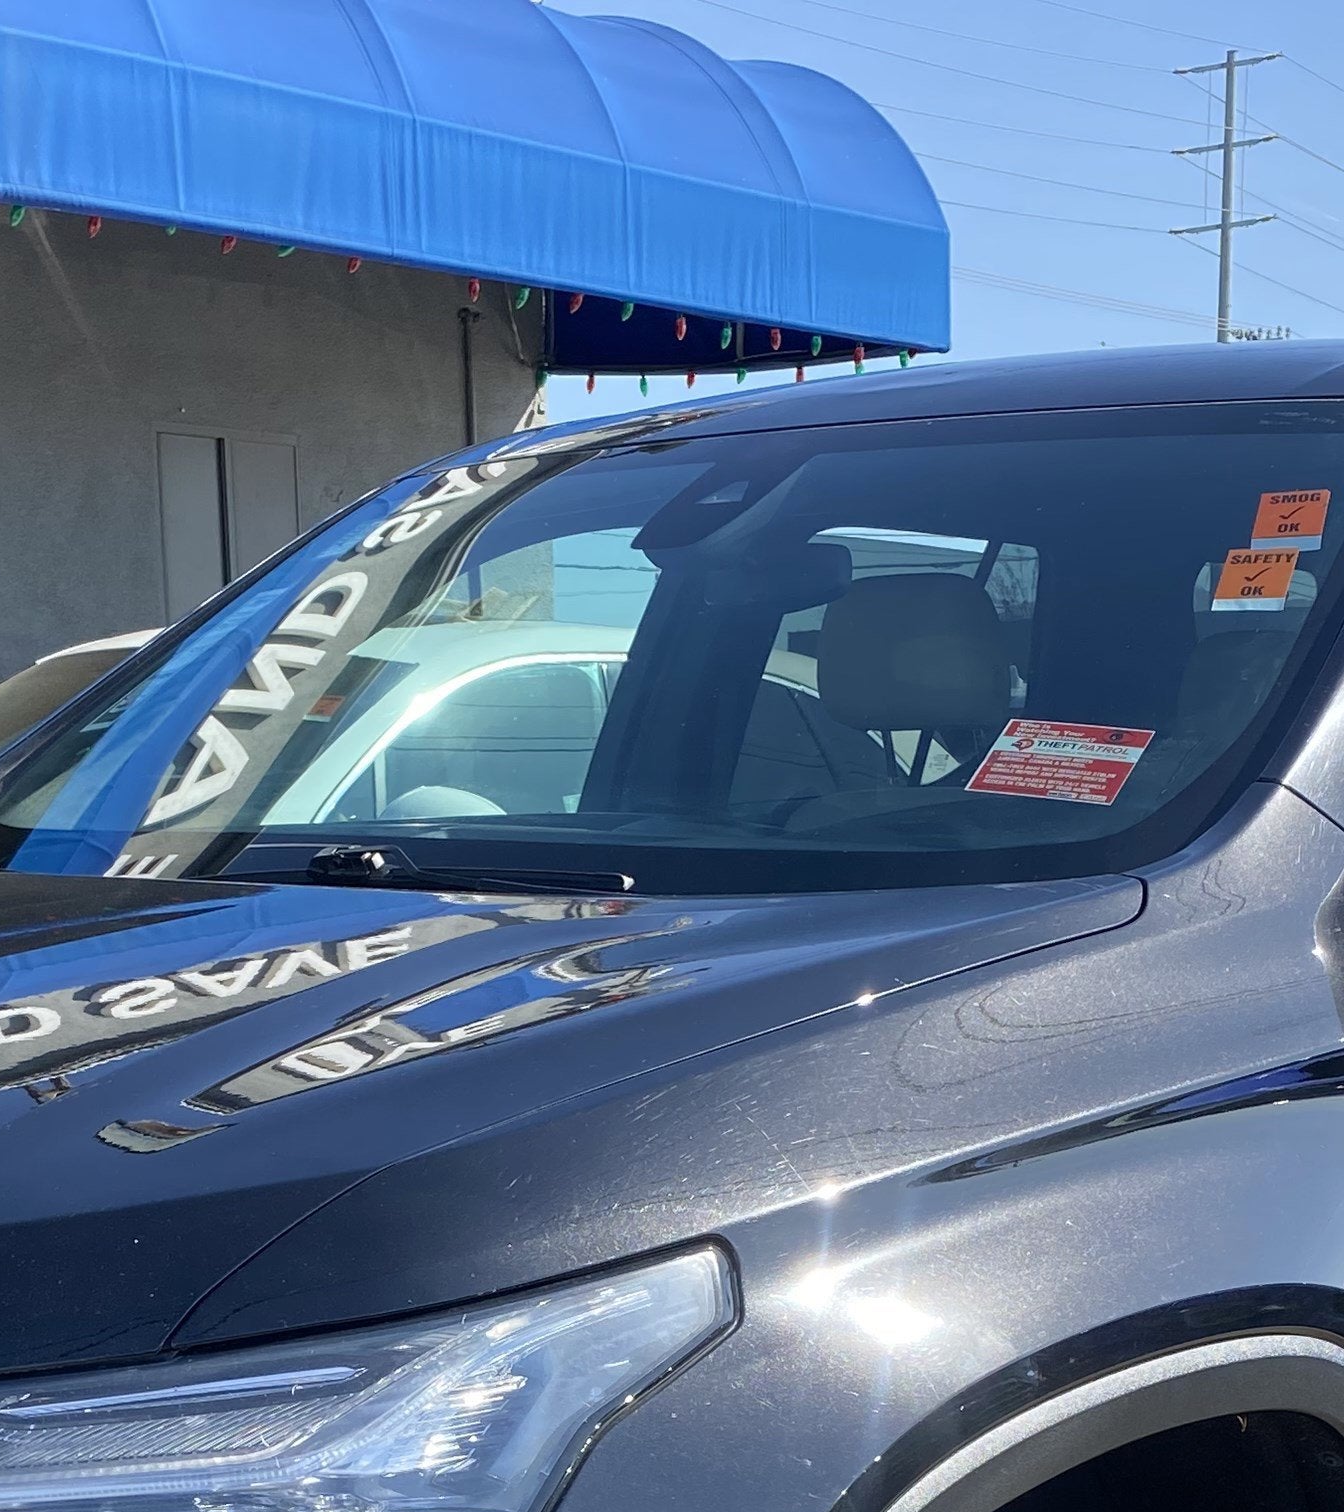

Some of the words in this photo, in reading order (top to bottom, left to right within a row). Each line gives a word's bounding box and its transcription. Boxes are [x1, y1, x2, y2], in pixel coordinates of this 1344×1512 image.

[1269, 492, 1321, 505] SMOG
[1277, 522, 1301, 533] OK
[1230, 553, 1296, 565] SAFETY
[1240, 586, 1265, 597] OK
[1036, 740, 1079, 750] THEFT
[1076, 744, 1130, 755] PATROL
